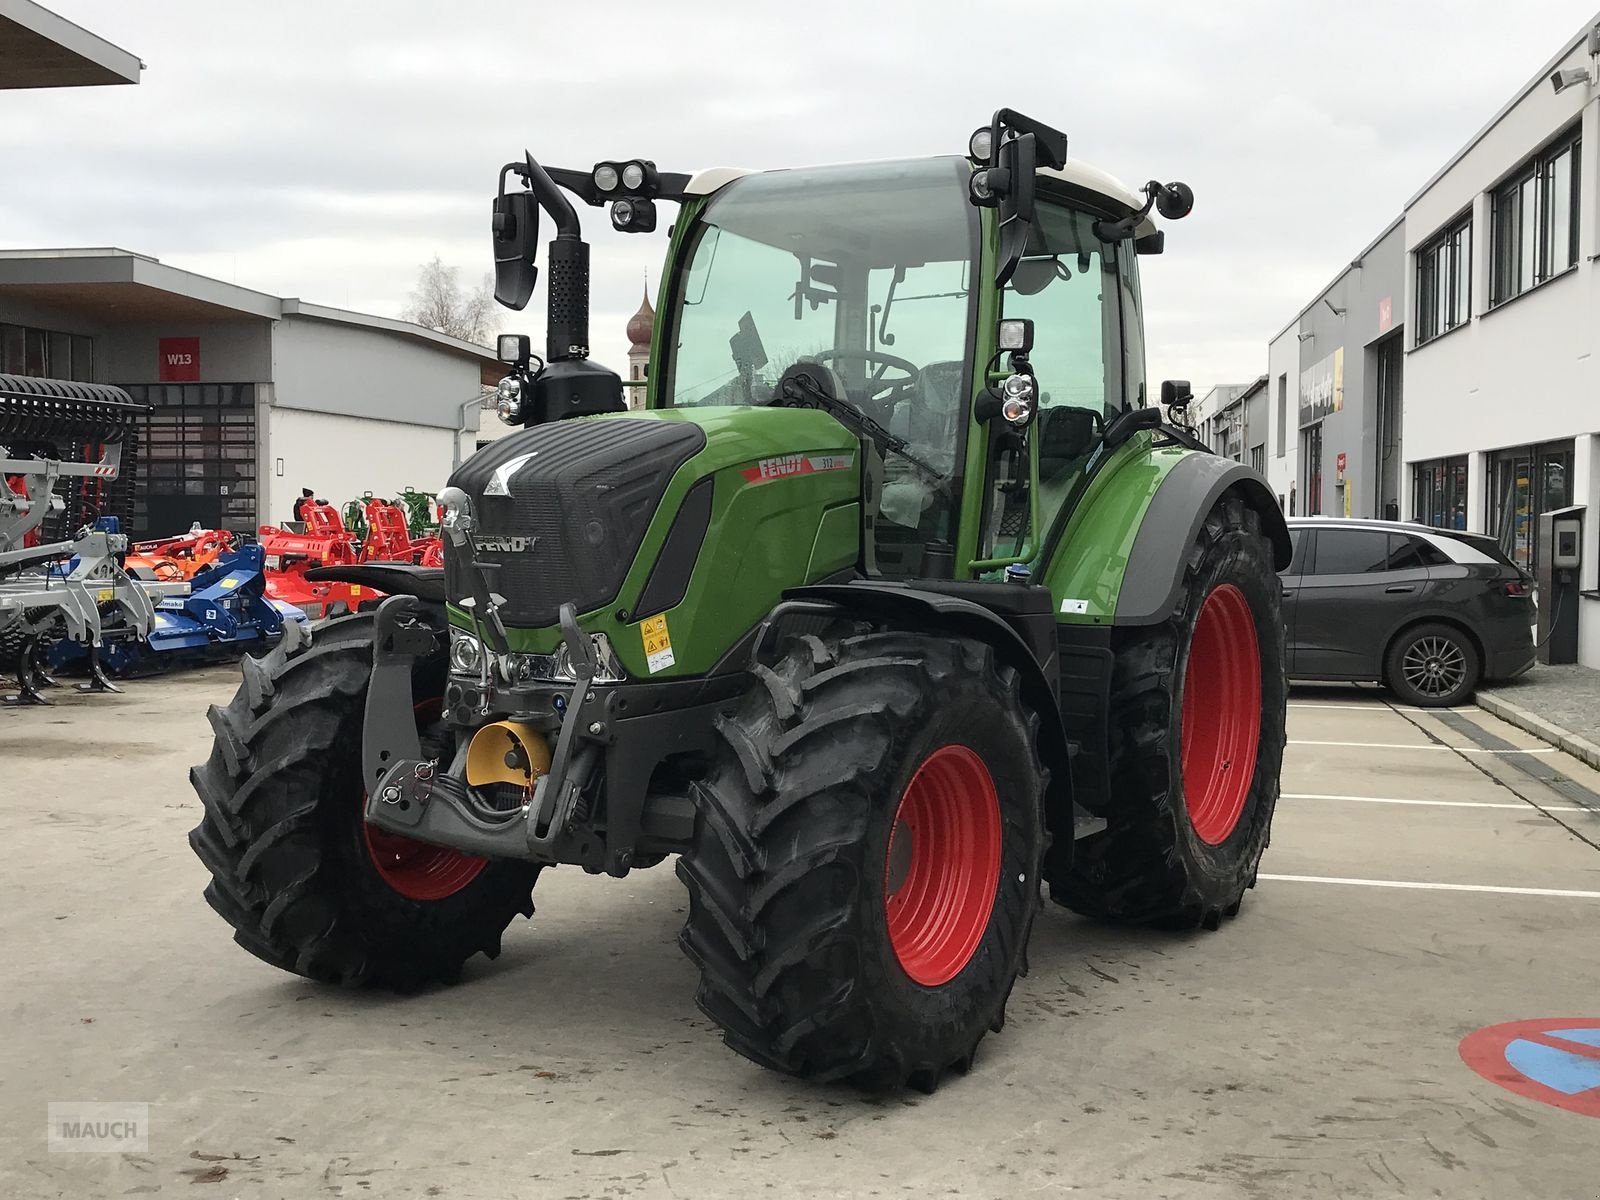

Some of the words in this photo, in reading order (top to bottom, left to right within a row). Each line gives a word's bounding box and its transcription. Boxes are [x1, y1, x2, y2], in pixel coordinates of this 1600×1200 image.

[167, 354, 192, 365] W13
[758, 454, 804, 478] FENDT
[822, 458, 833, 468] 312
[473, 536, 541, 552] FENDT
